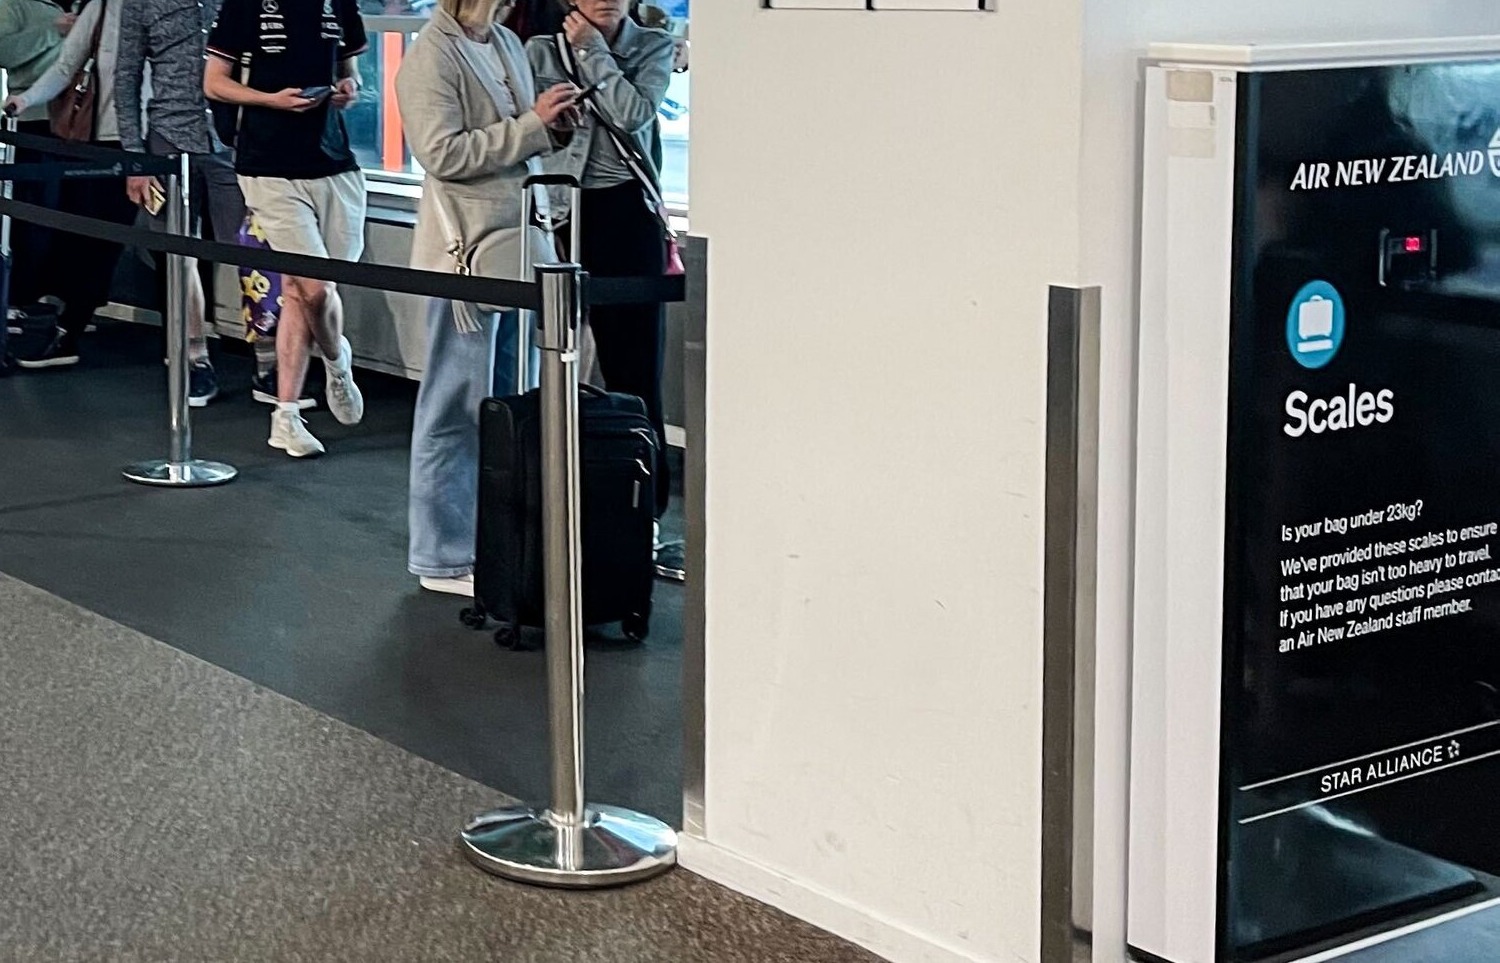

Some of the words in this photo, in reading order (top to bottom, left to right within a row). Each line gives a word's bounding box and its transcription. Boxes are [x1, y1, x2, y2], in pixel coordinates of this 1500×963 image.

[1289, 162, 1331, 191] AIR
[1335, 158, 1386, 187] NEW
[1387, 149, 1485, 182] ZEALAND
[1283, 382, 1394, 438] Scales
[1281, 524, 1293, 542] Is
[1294, 521, 1322, 543] your
[1324, 517, 1348, 534] bag
[1350, 509, 1385, 529] under
[1386, 499, 1423, 522] 23kg?
[1280, 556, 1318, 577] We've
[1319, 543, 1373, 573] provided
[1374, 539, 1407, 558] these
[1408, 531, 1445, 552] scales
[1446, 529, 1458, 544] to
[1460, 521, 1498, 541] ensure
[1279, 609, 1289, 628] If
[1290, 608, 1313, 629] you
[1315, 603, 1344, 620] have
[1346, 596, 1368, 614] any
[1369, 584, 1425, 612] questions
[1426, 575, 1464, 599] please
[1280, 582, 1305, 602] that
[1306, 579, 1335, 601] your
[1336, 574, 1359, 592] bag
[1361, 565, 1386, 586] isn't
[1387, 564, 1407, 581] too
[1409, 556, 1443, 574] heavy
[1445, 553, 1457, 568] to
[1278, 637, 1295, 653] an
[1296, 630, 1315, 649] Air
[1317, 626, 1345, 644] New
[1346, 612, 1394, 638] Zealand
[1395, 605, 1422, 627] staff
[1320, 766, 1362, 794] STAR
[1366, 745, 1443, 782] ALLIANCE
